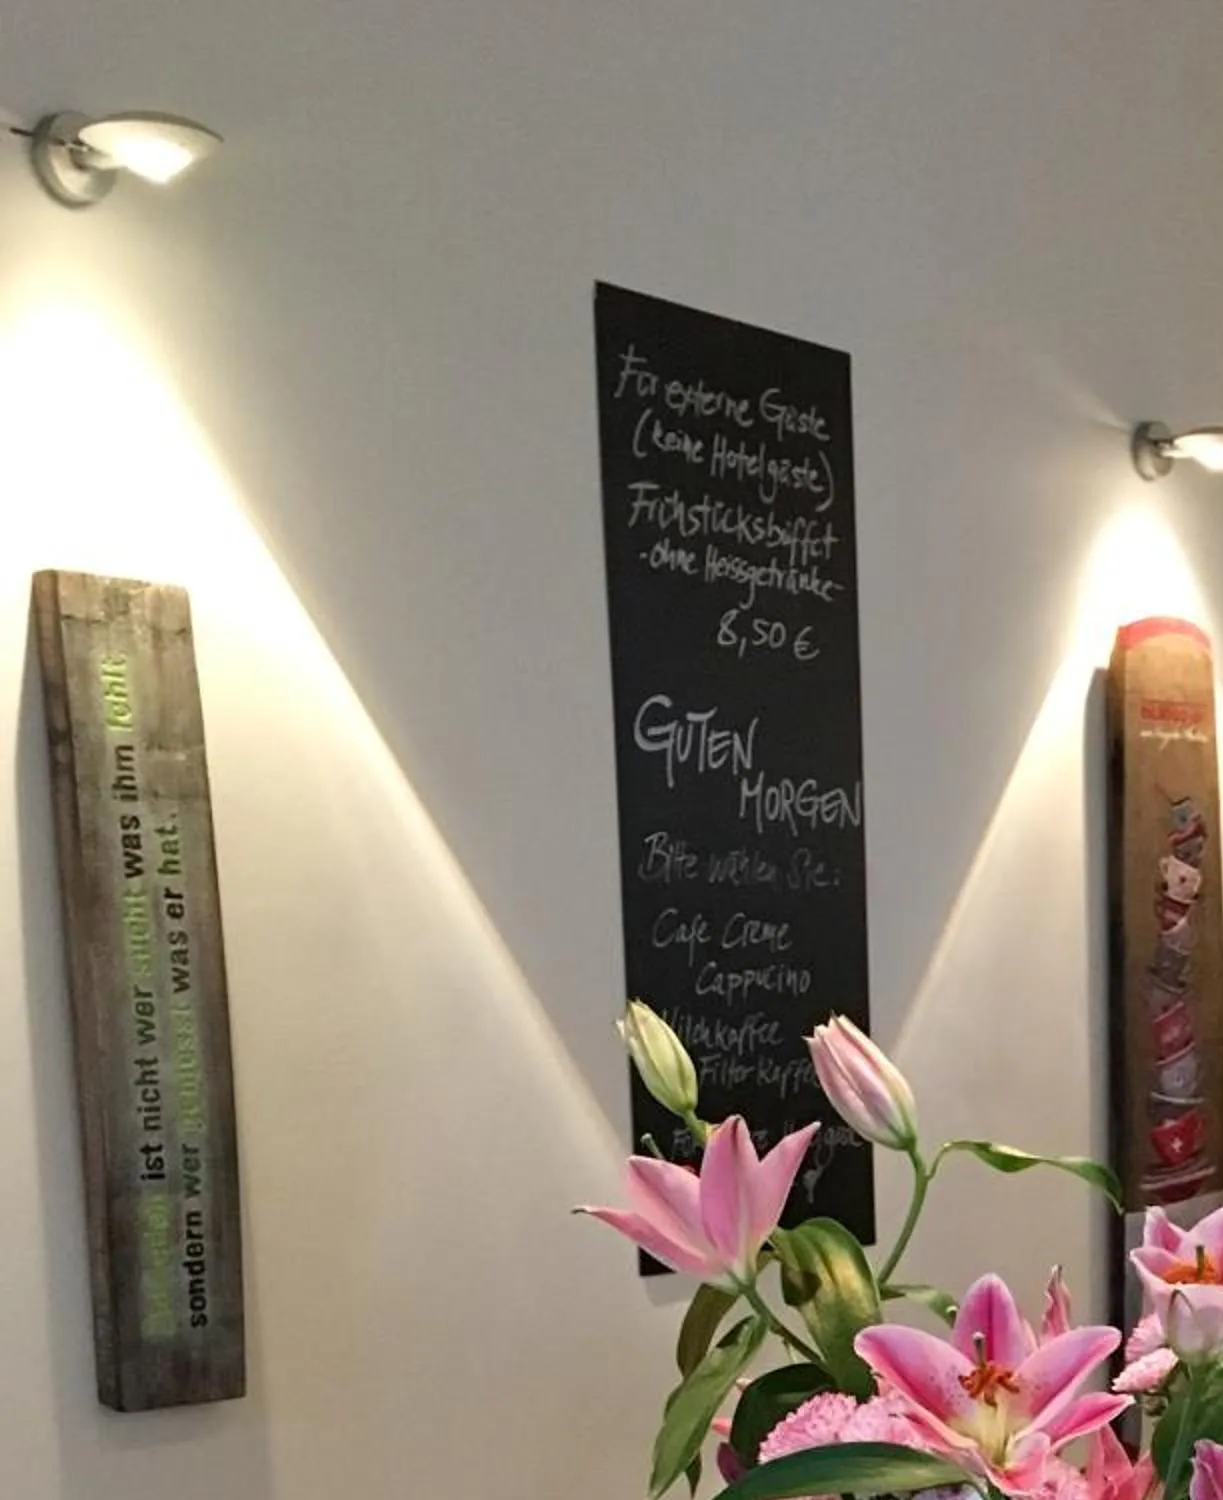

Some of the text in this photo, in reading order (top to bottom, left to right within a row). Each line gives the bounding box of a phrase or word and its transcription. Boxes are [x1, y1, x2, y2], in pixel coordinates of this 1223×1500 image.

[716, 608, 820, 661] 8,50 €
[112, 743, 138, 802] ihm
[632, 693, 862, 837] GUTEN MORGEN
[120, 813, 144, 879] was
[162, 886, 185, 921] er
[168, 929, 191, 994] was
[134, 984, 157, 1047] wer
[133, 1056, 162, 1132] nicht
[139, 1143, 166, 1182] ist
[181, 1143, 202, 1199] wer
[182, 1210, 209, 1330] sondern
